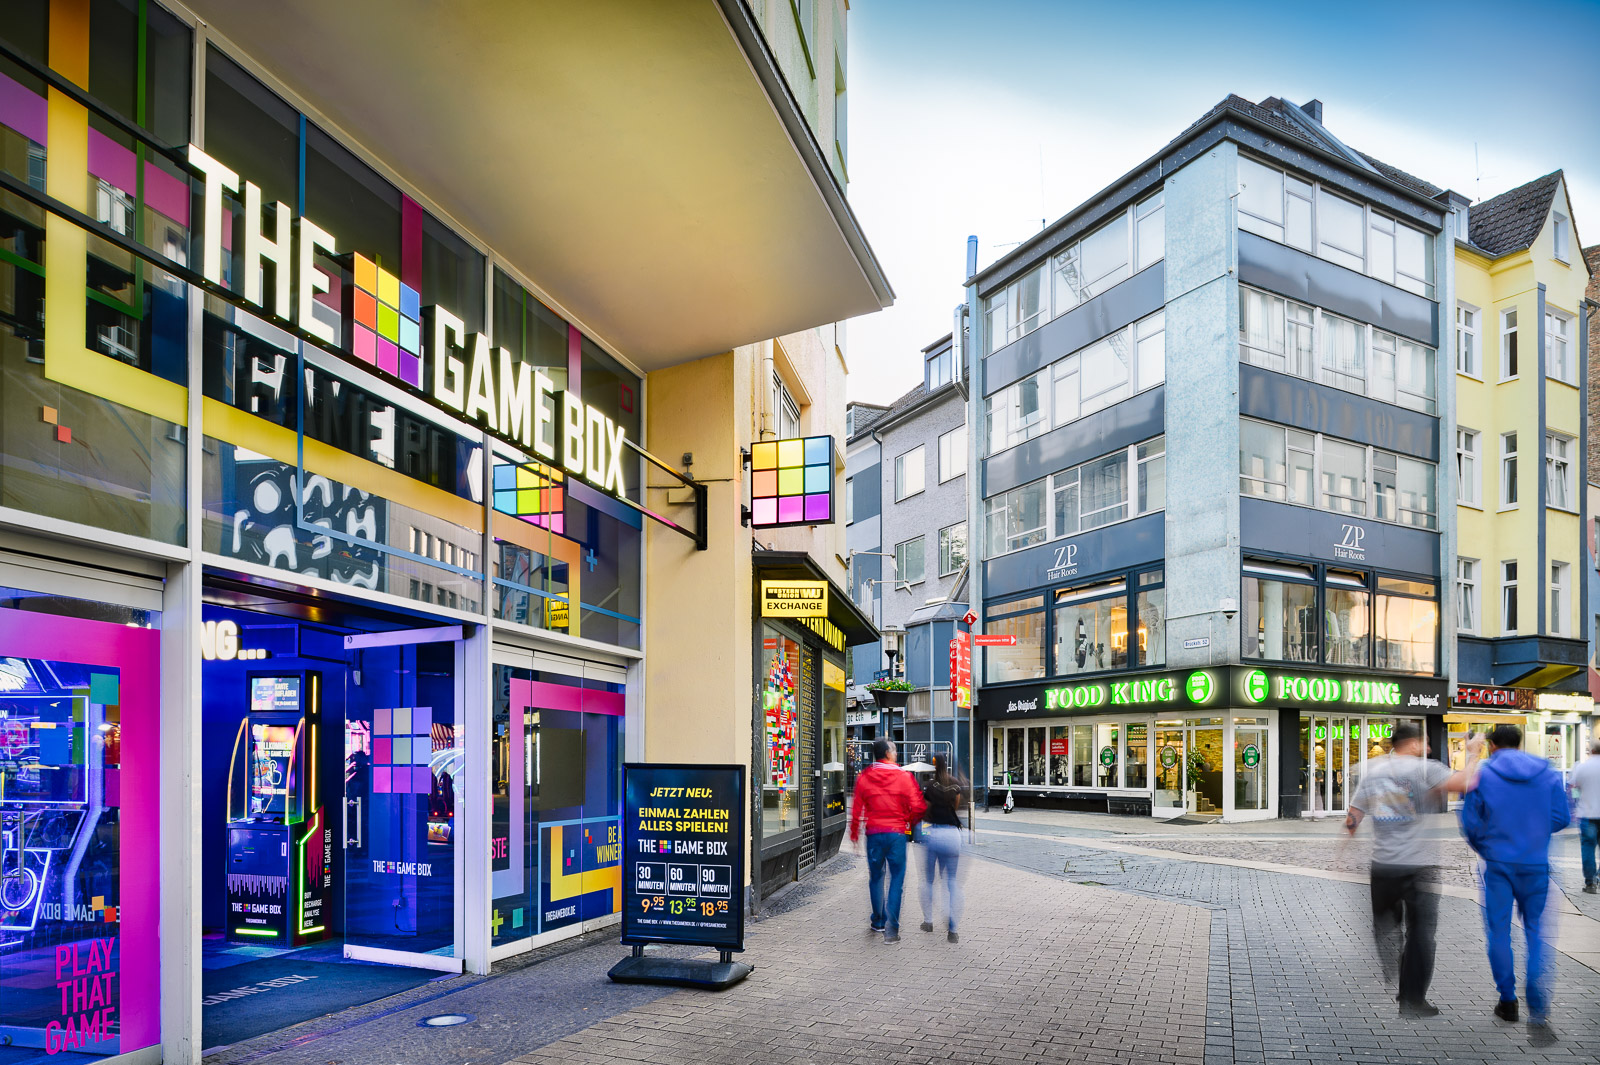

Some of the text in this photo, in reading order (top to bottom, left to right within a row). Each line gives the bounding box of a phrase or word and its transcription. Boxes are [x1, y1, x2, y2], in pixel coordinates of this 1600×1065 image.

[188, 143, 626, 499] THE GAME BOX
[1342, 524, 1365, 547] ZP
[1054, 544, 1077, 568] ZP
[1335, 547, 1365, 560] Hair Roots
[1047, 568, 1078, 581] Hair Roots
[766, 602, 823, 610] EXCHANGE
[1045, 678, 1175, 709] FOOD KING
[1278, 676, 1401, 705] FOOD KING
[650, 787, 713, 798] JETZT NEU:
[638, 807, 729, 820] EINMAL ZAHLEN
[638, 820, 728, 833] ALLES SPIELEN!
[324, 829, 332, 842] BOX
[608, 825, 617, 843] BE
[324, 843, 332, 864] GAME
[596, 843, 622, 864] WINNER
[638, 839, 728, 856] THE GAME BOX
[373, 860, 432, 876] THE GAME BOX
[638, 866, 651, 879] 30
[670, 867, 683, 881] 60
[702, 869, 715, 882] 90
[637, 880, 664, 890] MINUTEN
[669, 881, 696, 892] MINUTEN
[701, 883, 729, 893] MINUTEN
[232, 903, 281, 915] THE GAME BOX
[545, 905, 576, 922] THEGAMEBOX.DE
[55, 937, 115, 980] PLAY
[256, 974, 319, 988] BOX
[57, 972, 116, 1016] THAT
[45, 1006, 115, 1055] GAME
